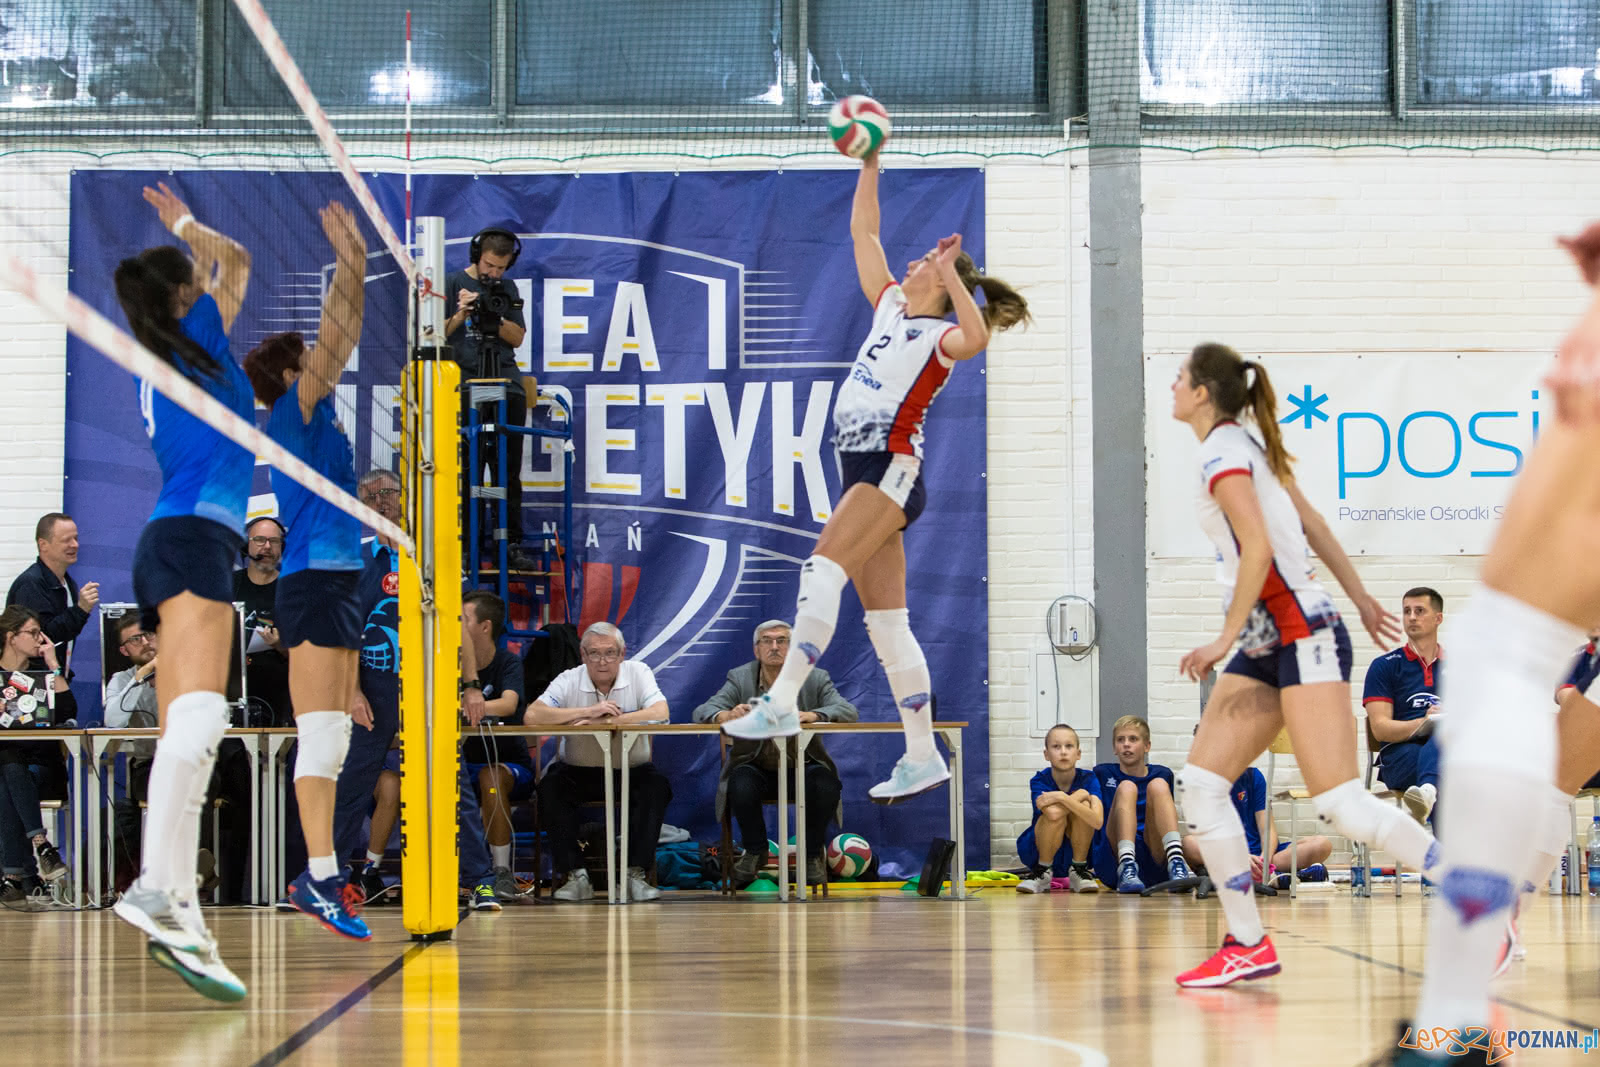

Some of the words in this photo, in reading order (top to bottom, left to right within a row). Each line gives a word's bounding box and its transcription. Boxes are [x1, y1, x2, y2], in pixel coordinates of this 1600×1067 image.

[866, 335, 892, 361] 2
[1337, 390, 1540, 500] posi
[1338, 505, 1426, 521] Poznańskie
[1430, 505, 1490, 521] Ośrodki
